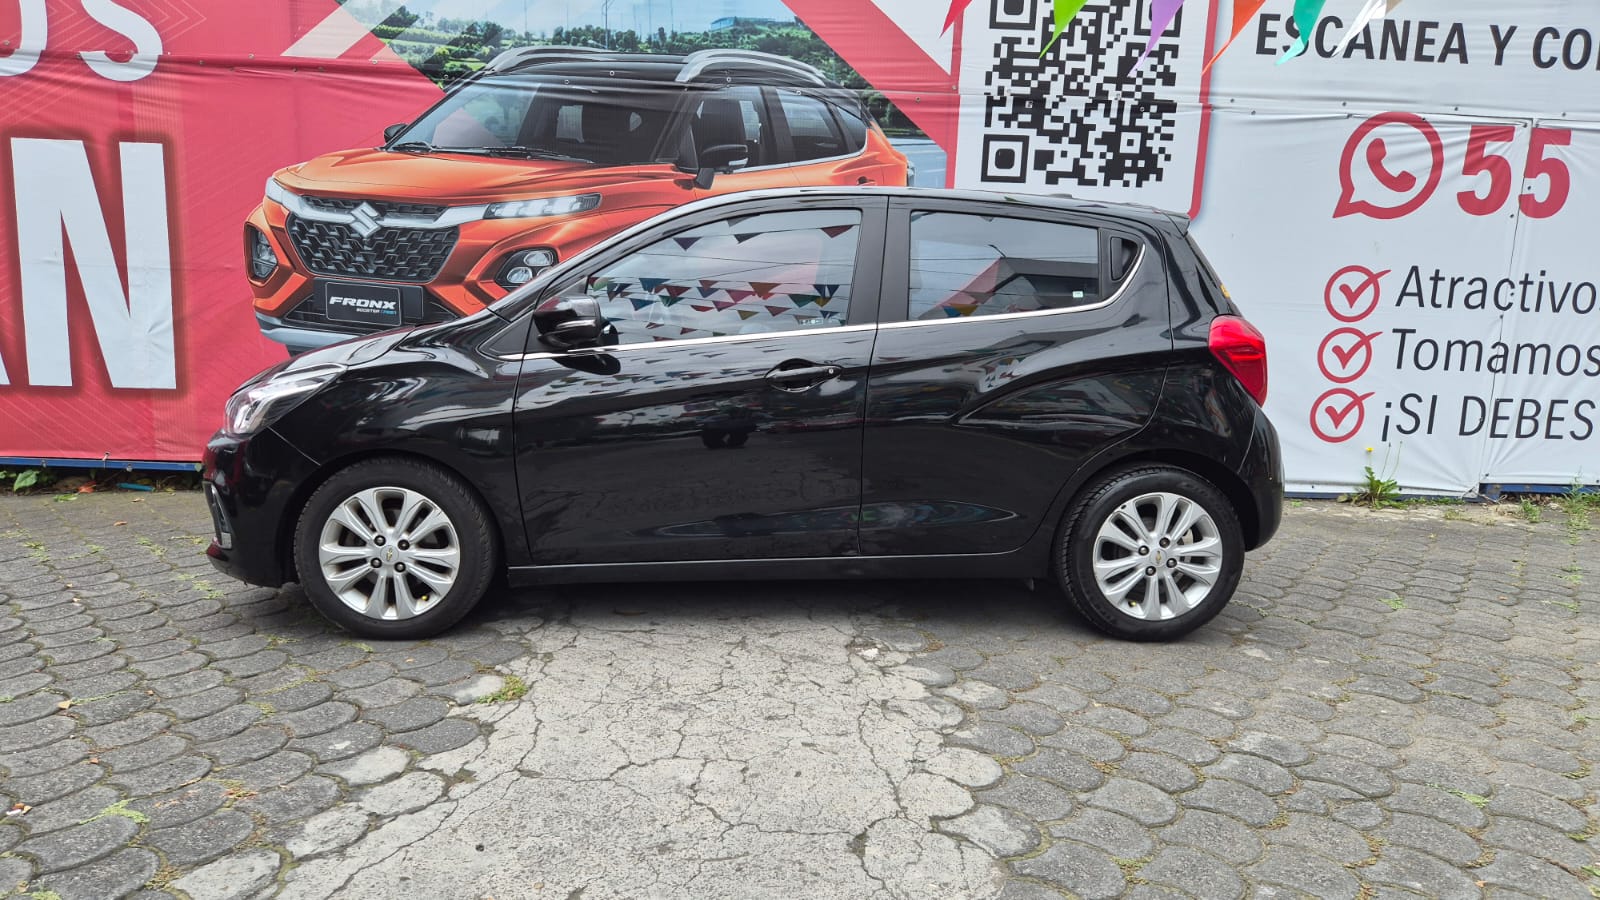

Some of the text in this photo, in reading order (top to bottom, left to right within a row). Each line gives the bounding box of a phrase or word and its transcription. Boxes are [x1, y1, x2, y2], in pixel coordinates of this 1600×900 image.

[1256, 13, 1600, 71] ESCANEA Y CO
[1456, 124, 1572, 219] 55
[329, 296, 397, 310] FRONX
[1395, 265, 1600, 314] Atractivo
[1392, 328, 1600, 376] Tomamos
[1381, 393, 1597, 442] ¡SI DEBES
